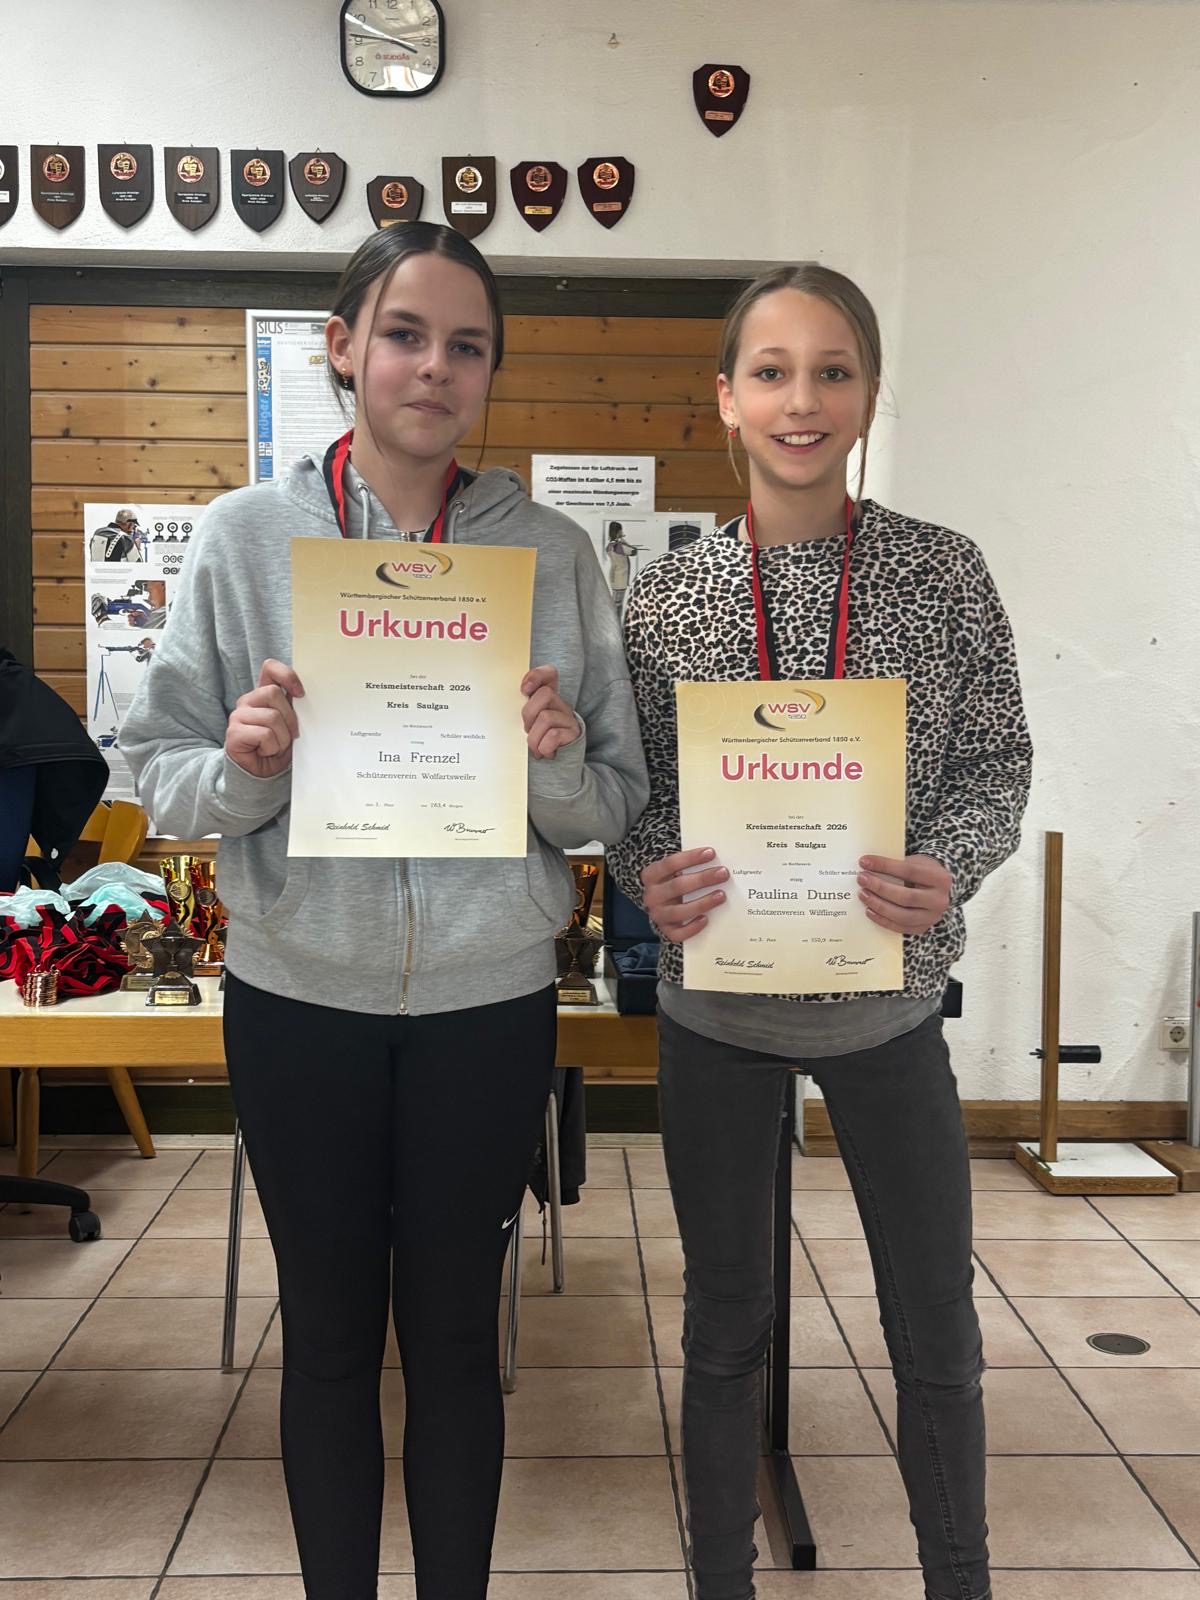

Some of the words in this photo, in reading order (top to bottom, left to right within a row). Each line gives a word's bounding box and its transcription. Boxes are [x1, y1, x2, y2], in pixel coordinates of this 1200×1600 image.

[422, 16, 431, 26] 2
[422, 37, 431, 47] 3
[355, 56, 364, 66] 8
[422, 58, 432, 68] 4
[369, 72, 377, 82] 7
[392, 562, 437, 574] WSV
[340, 592, 401, 600] Württembergischer
[402, 594, 456, 602] Schützenverband
[339, 610, 488, 641] Urkunde
[365, 682, 444, 691] Kreismeisterschaft
[449, 684, 471, 692] 2026
[416, 702, 449, 711] Saulgau
[768, 704, 812, 714] WSV
[378, 751, 401, 762] Ina
[410, 752, 460, 764] Frenzel
[721, 752, 864, 782] Urkunde
[356, 772, 417, 780] Schützenverein
[422, 772, 477, 780] Wolfartsweiler
[794, 842, 827, 850] Saulgau
[748, 888, 798, 900] Paulina
[807, 889, 852, 900] Dunse
[747, 908, 805, 916] Schützenverein
